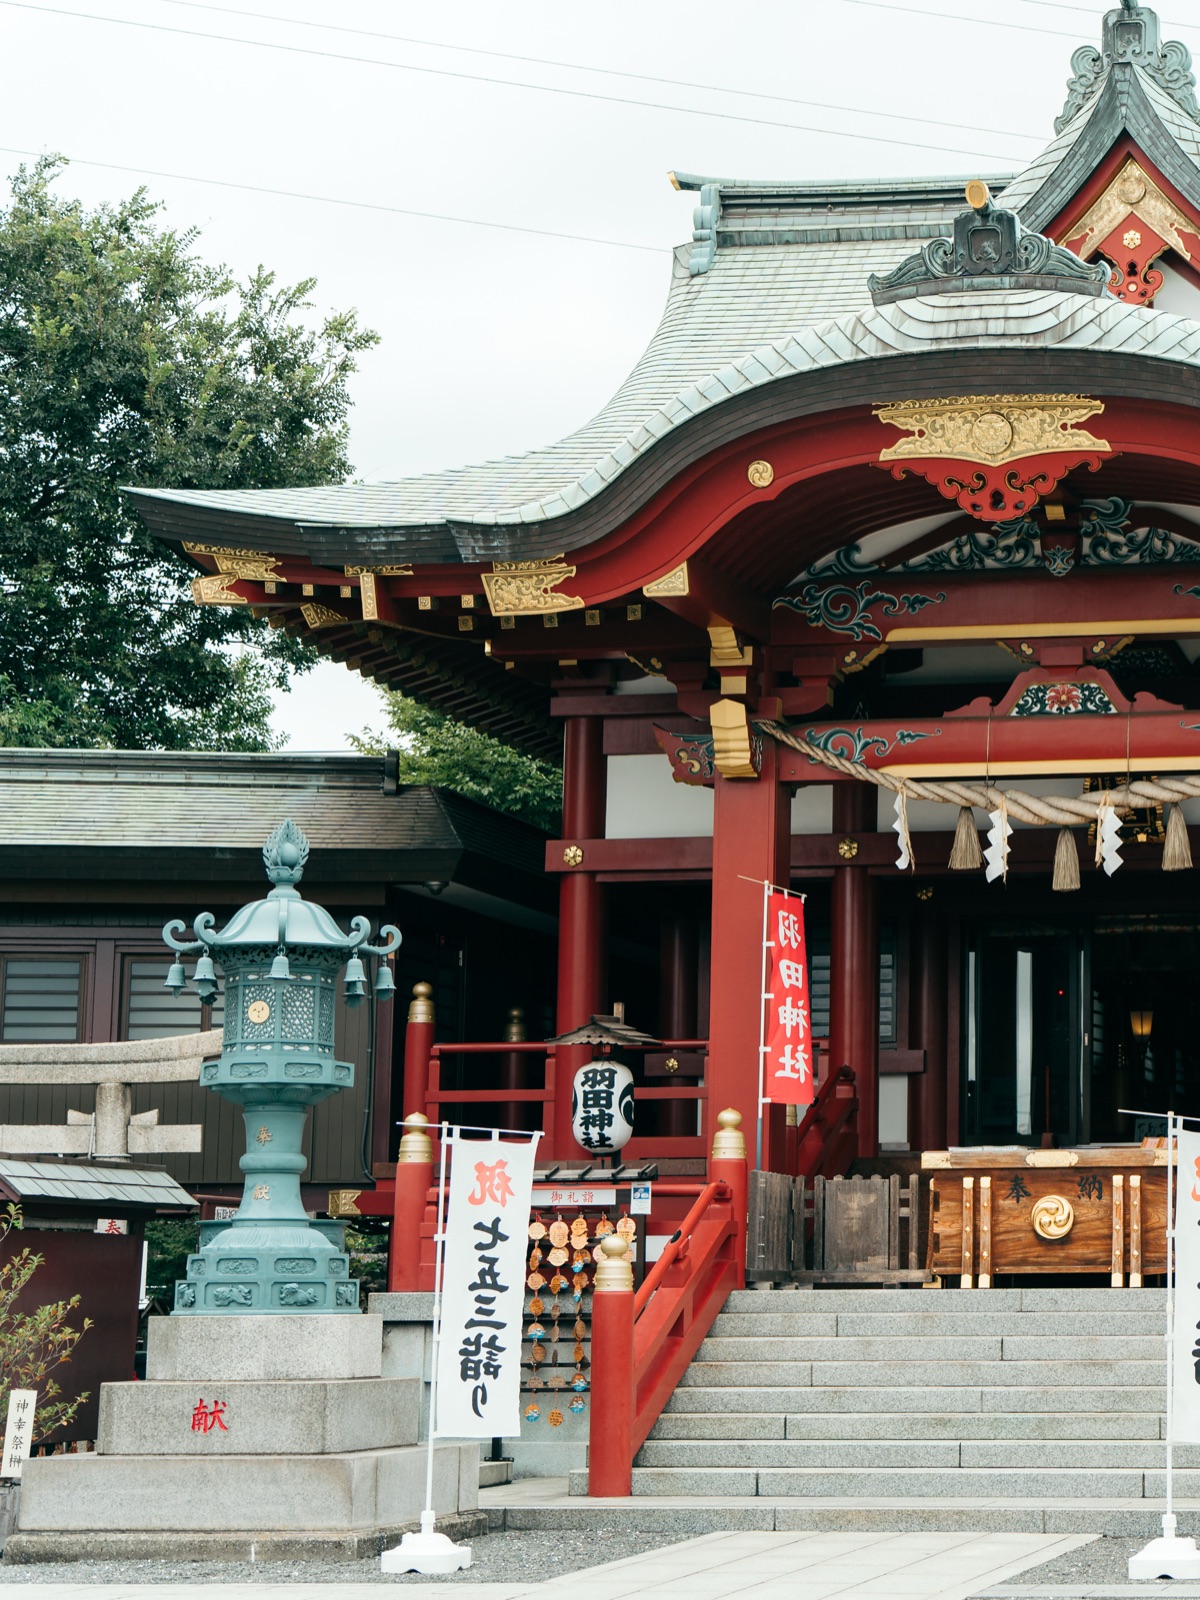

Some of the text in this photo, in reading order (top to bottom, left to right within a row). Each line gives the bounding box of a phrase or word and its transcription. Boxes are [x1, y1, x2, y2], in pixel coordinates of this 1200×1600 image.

[579, 1067, 617, 1149] 羽田神社
[253, 1125, 273, 1201] 奉 献
[1005, 1174, 1103, 1204] 奉 納
[191, 1398, 229, 1434] 献
